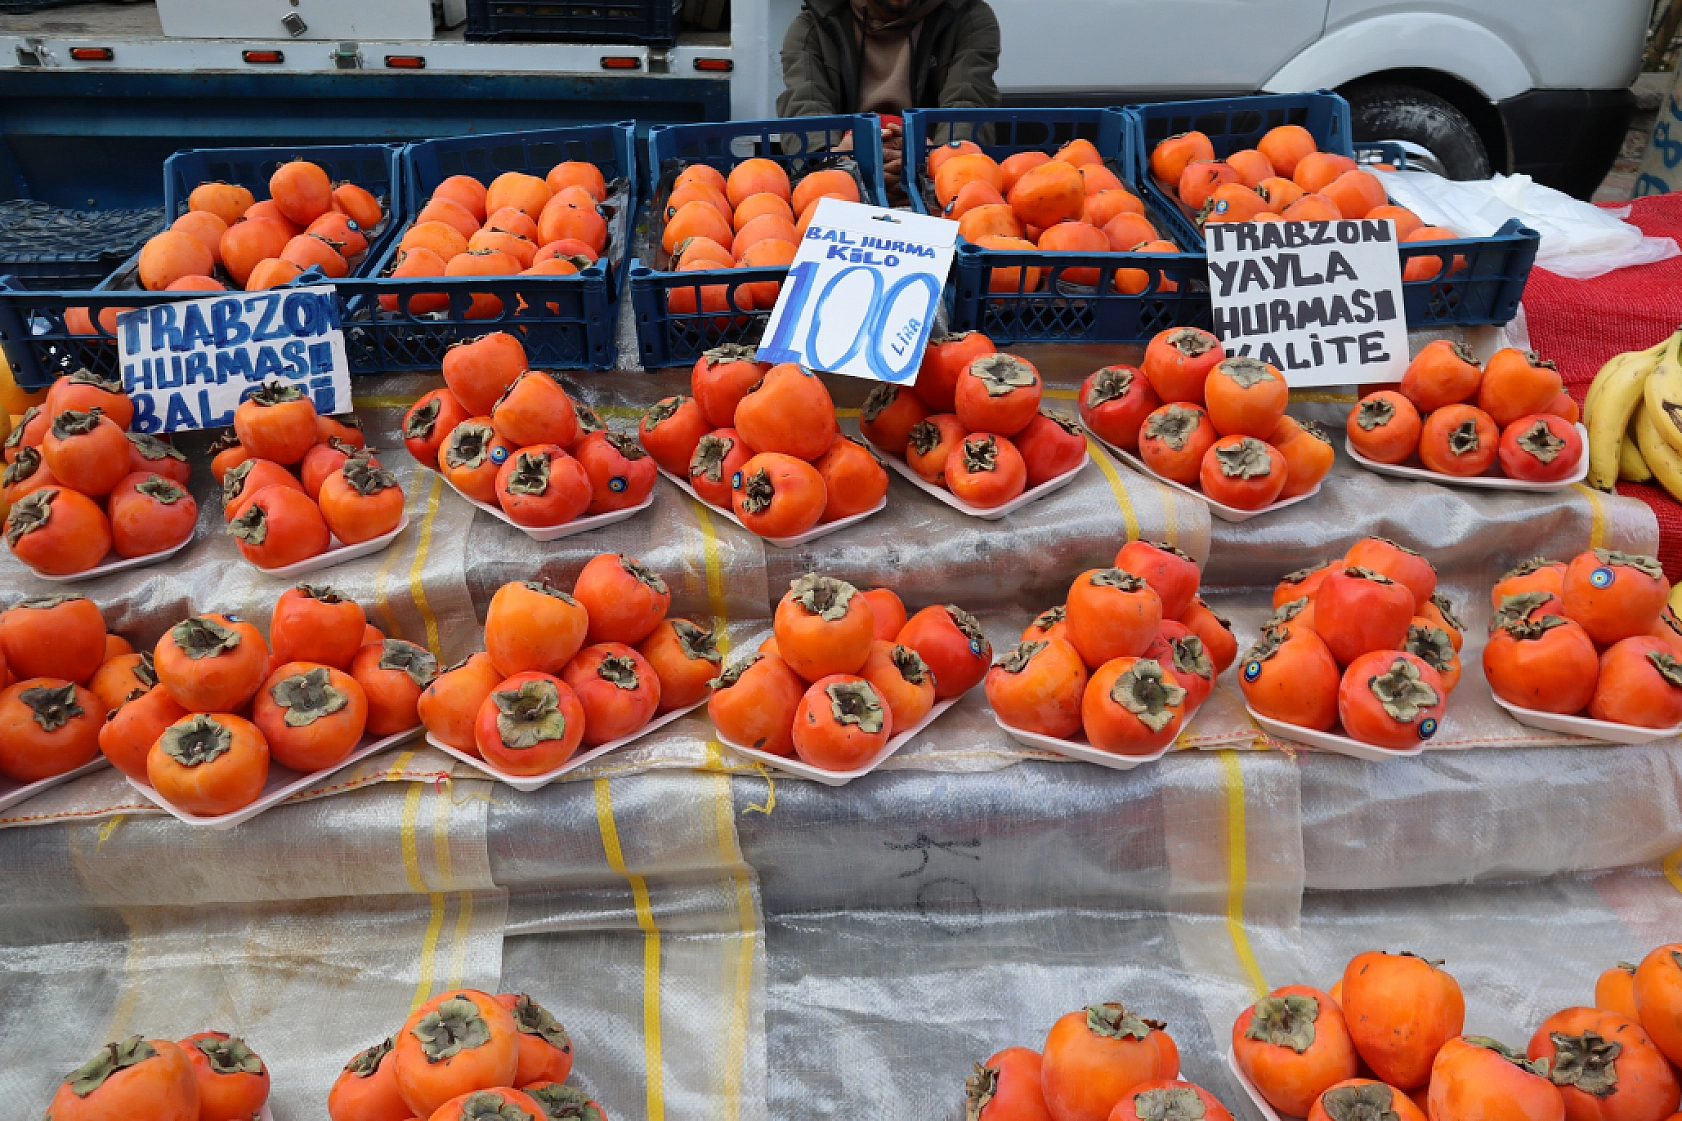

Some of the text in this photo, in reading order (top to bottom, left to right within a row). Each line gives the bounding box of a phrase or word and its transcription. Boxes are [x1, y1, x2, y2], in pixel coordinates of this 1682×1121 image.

[805, 226, 936, 258] BAL HURMA
[1206, 219, 1391, 252] TRABZON
[1208, 251, 1358, 297] YAYLA
[116, 292, 341, 355] TRABZON
[754, 261, 941, 381] 100
[1213, 289, 1397, 341] HURMASI
[123, 340, 334, 394] HURMASI
[131, 389, 235, 433] BAL
